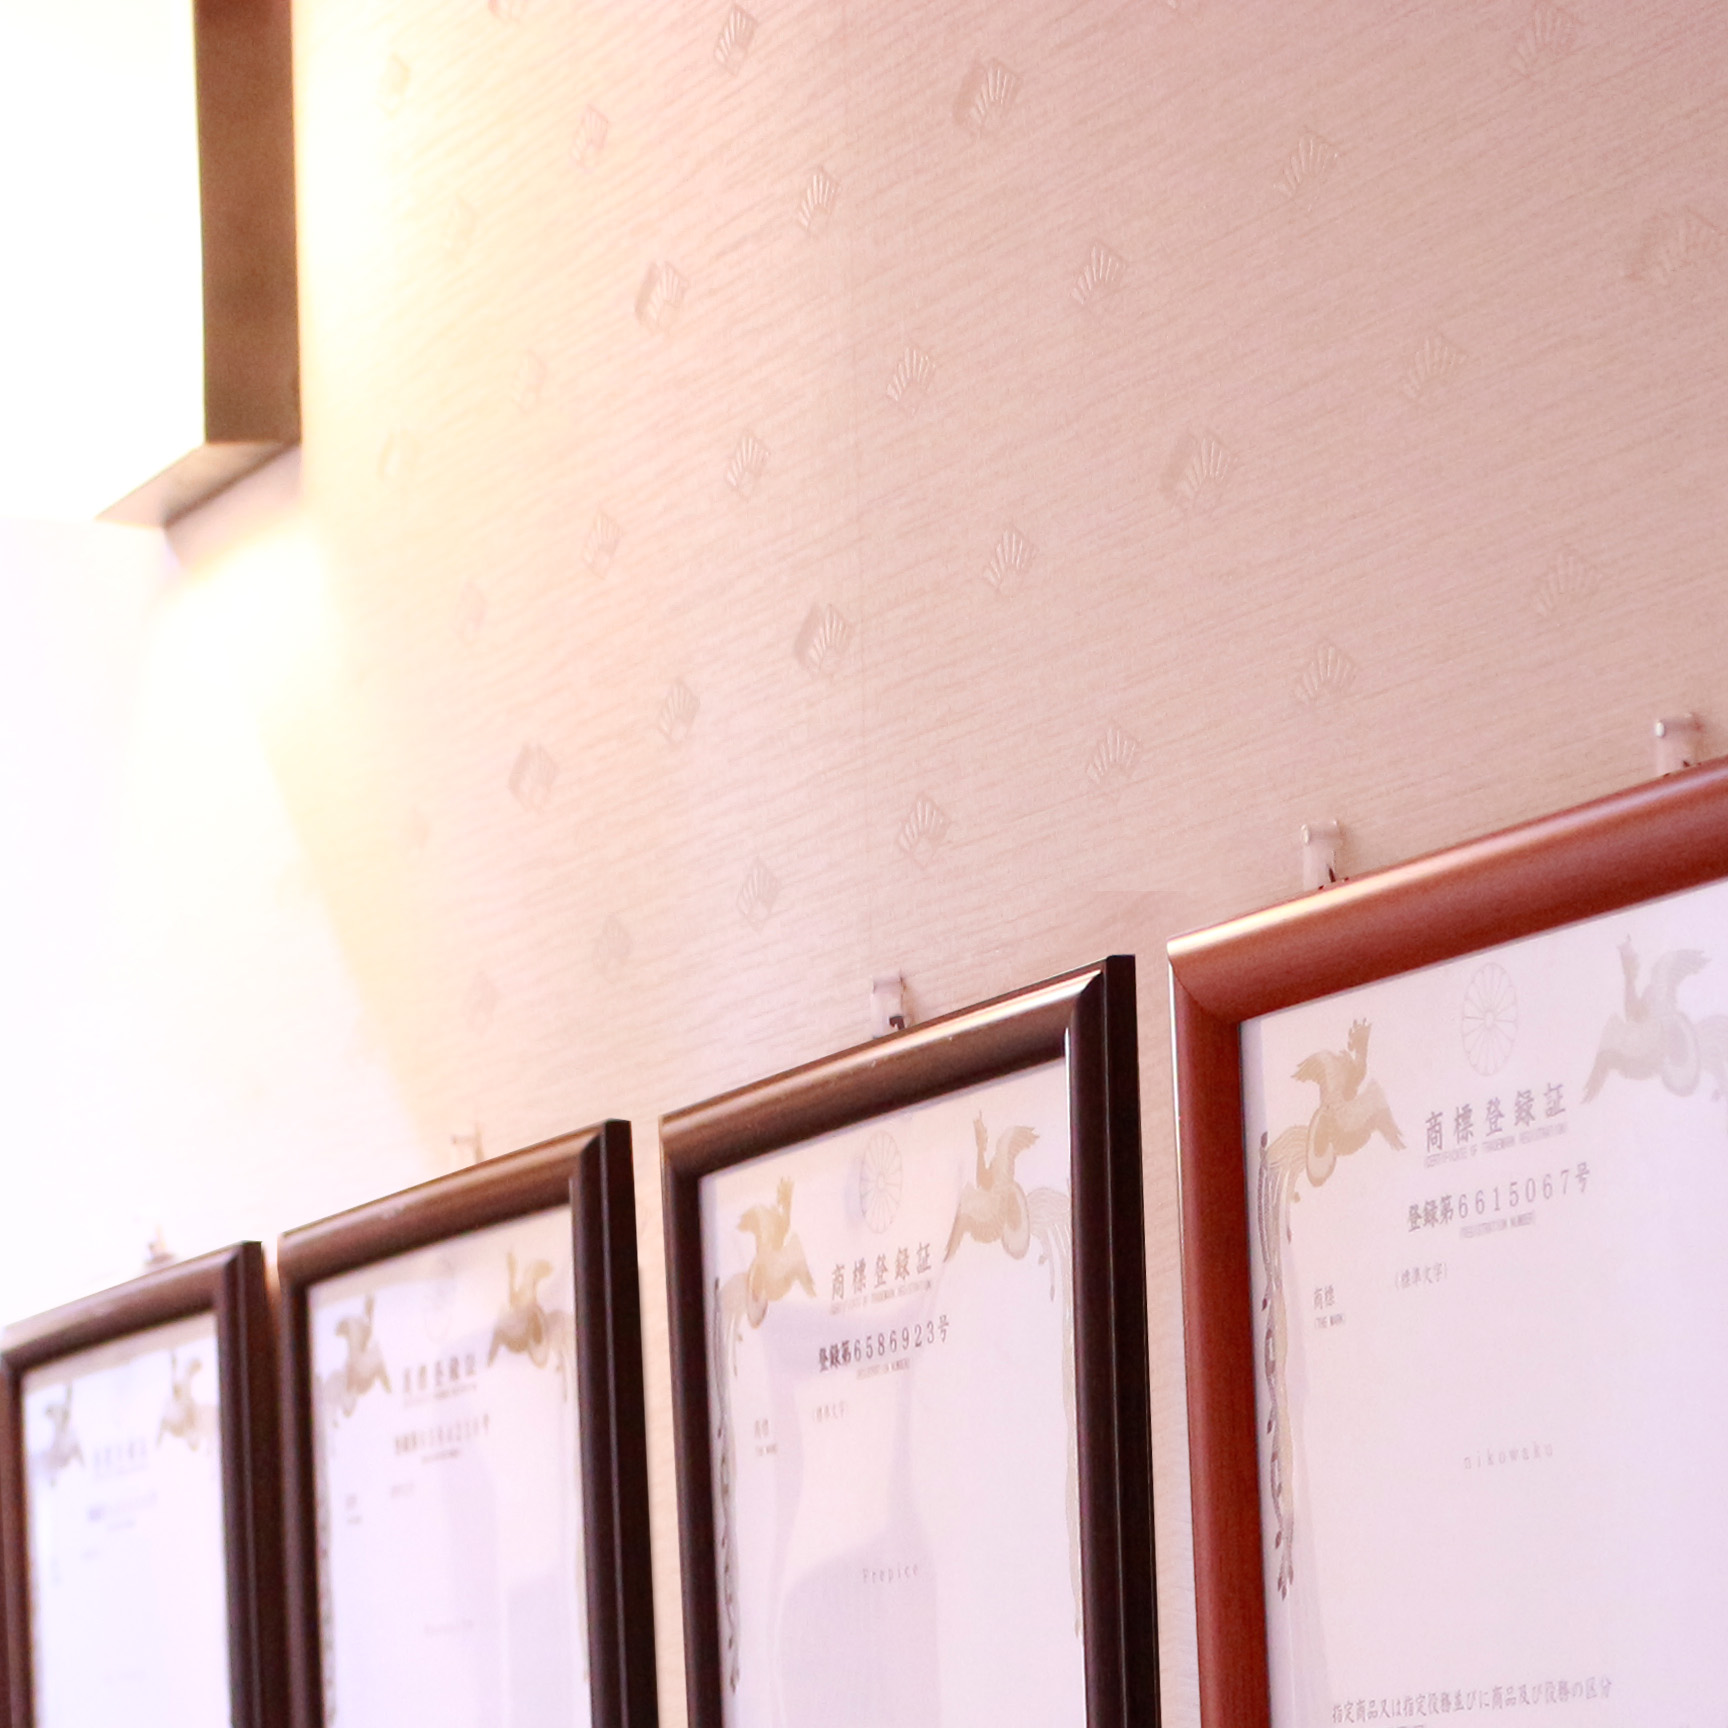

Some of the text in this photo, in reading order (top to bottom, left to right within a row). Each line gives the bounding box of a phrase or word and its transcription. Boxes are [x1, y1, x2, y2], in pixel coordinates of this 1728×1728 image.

[1425, 1082, 1566, 1153] 商標登録証
[1408, 1161, 1590, 1233] 登録第6615067号
[832, 1241, 932, 1301] 商標登録証
[1314, 1284, 1334, 1310] 商標
[818, 1313, 950, 1374] 登録第6586923号
[1332, 1675, 1612, 1724] 指定商品又は指定役務並びに商品及び役務の区分
